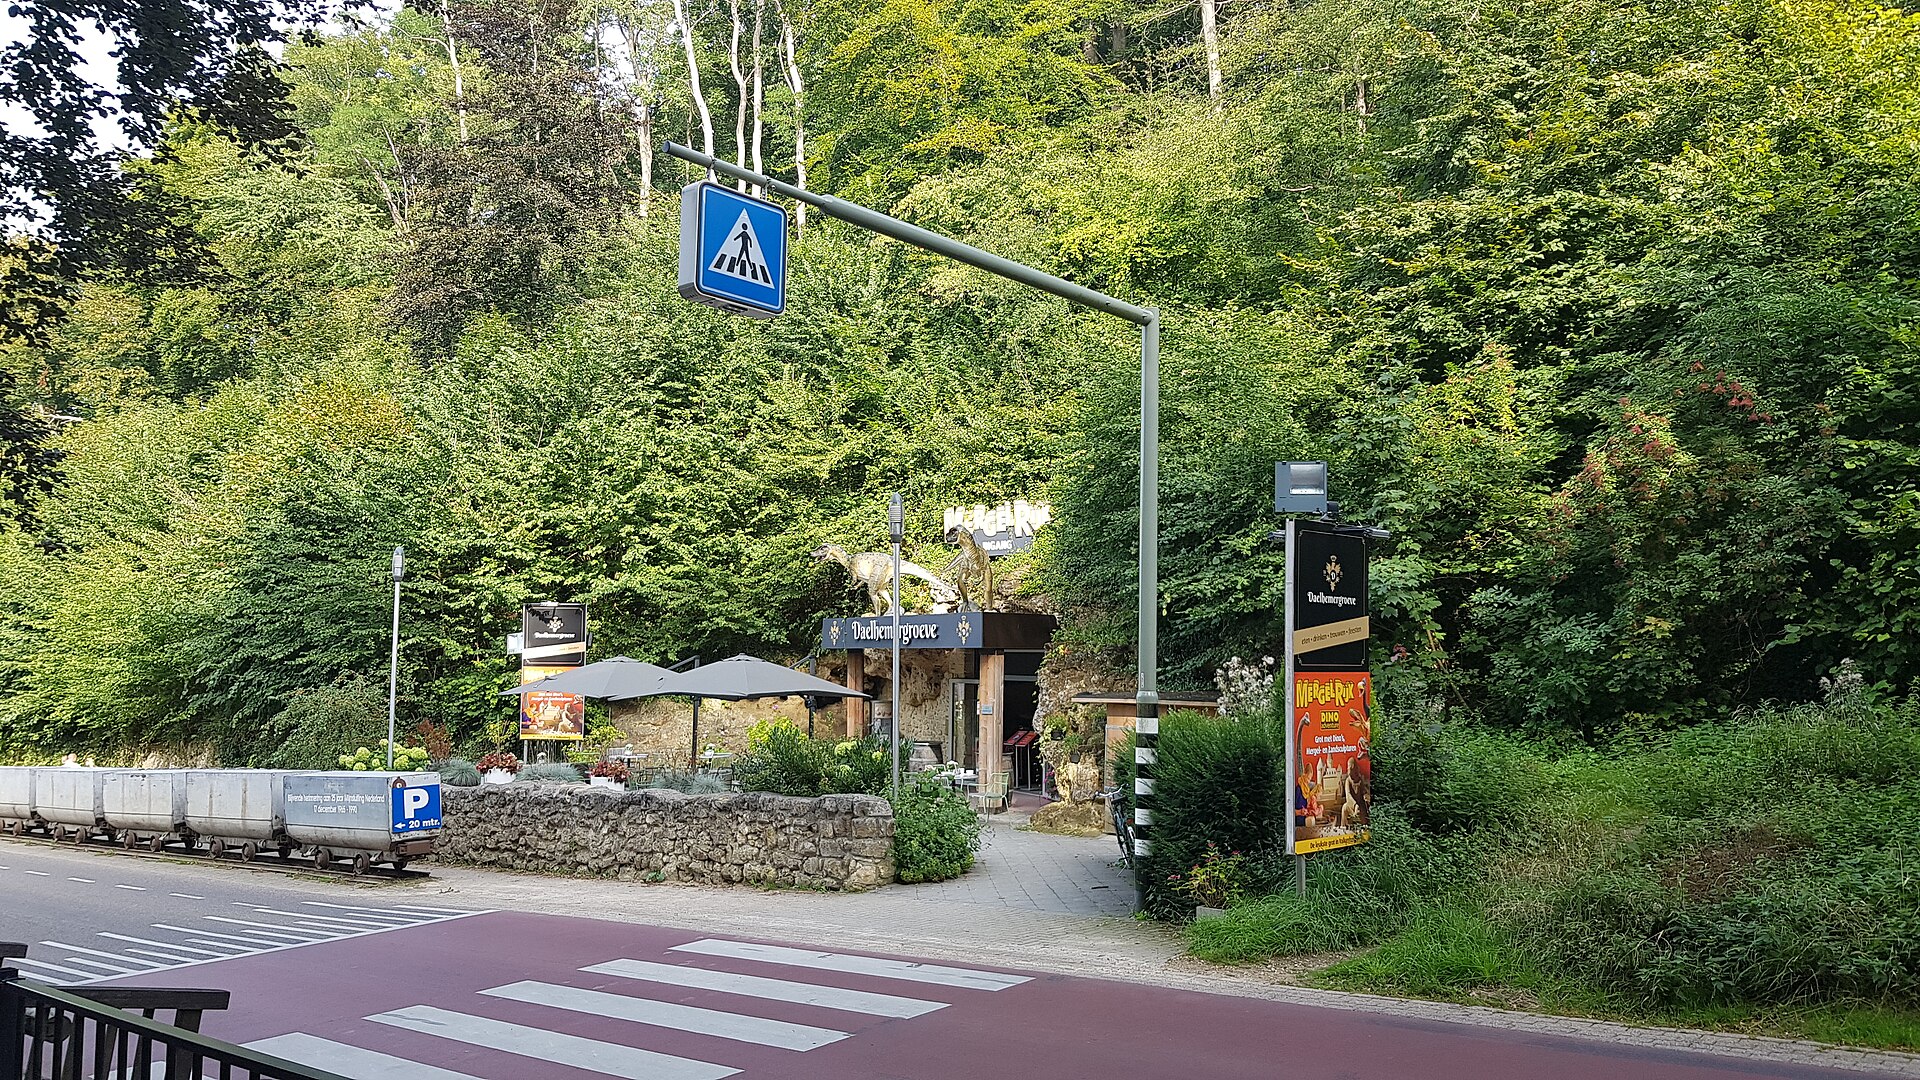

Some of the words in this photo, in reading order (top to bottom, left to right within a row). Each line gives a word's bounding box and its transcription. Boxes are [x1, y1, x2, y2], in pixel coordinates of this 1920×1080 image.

[1307, 591, 1356, 607] Daelhemergroeve
[852, 620, 938, 645] Daelhemrgroeve
[1321, 711, 1339, 722] DINO
[1314, 735, 1323, 743] Grot
[1324, 735, 1332, 743] met
[404, 788, 429, 819] P
[317, 805, 337, 814] december
[408, 819, 420, 829] 20
[422, 818, 440, 827] mtr.
